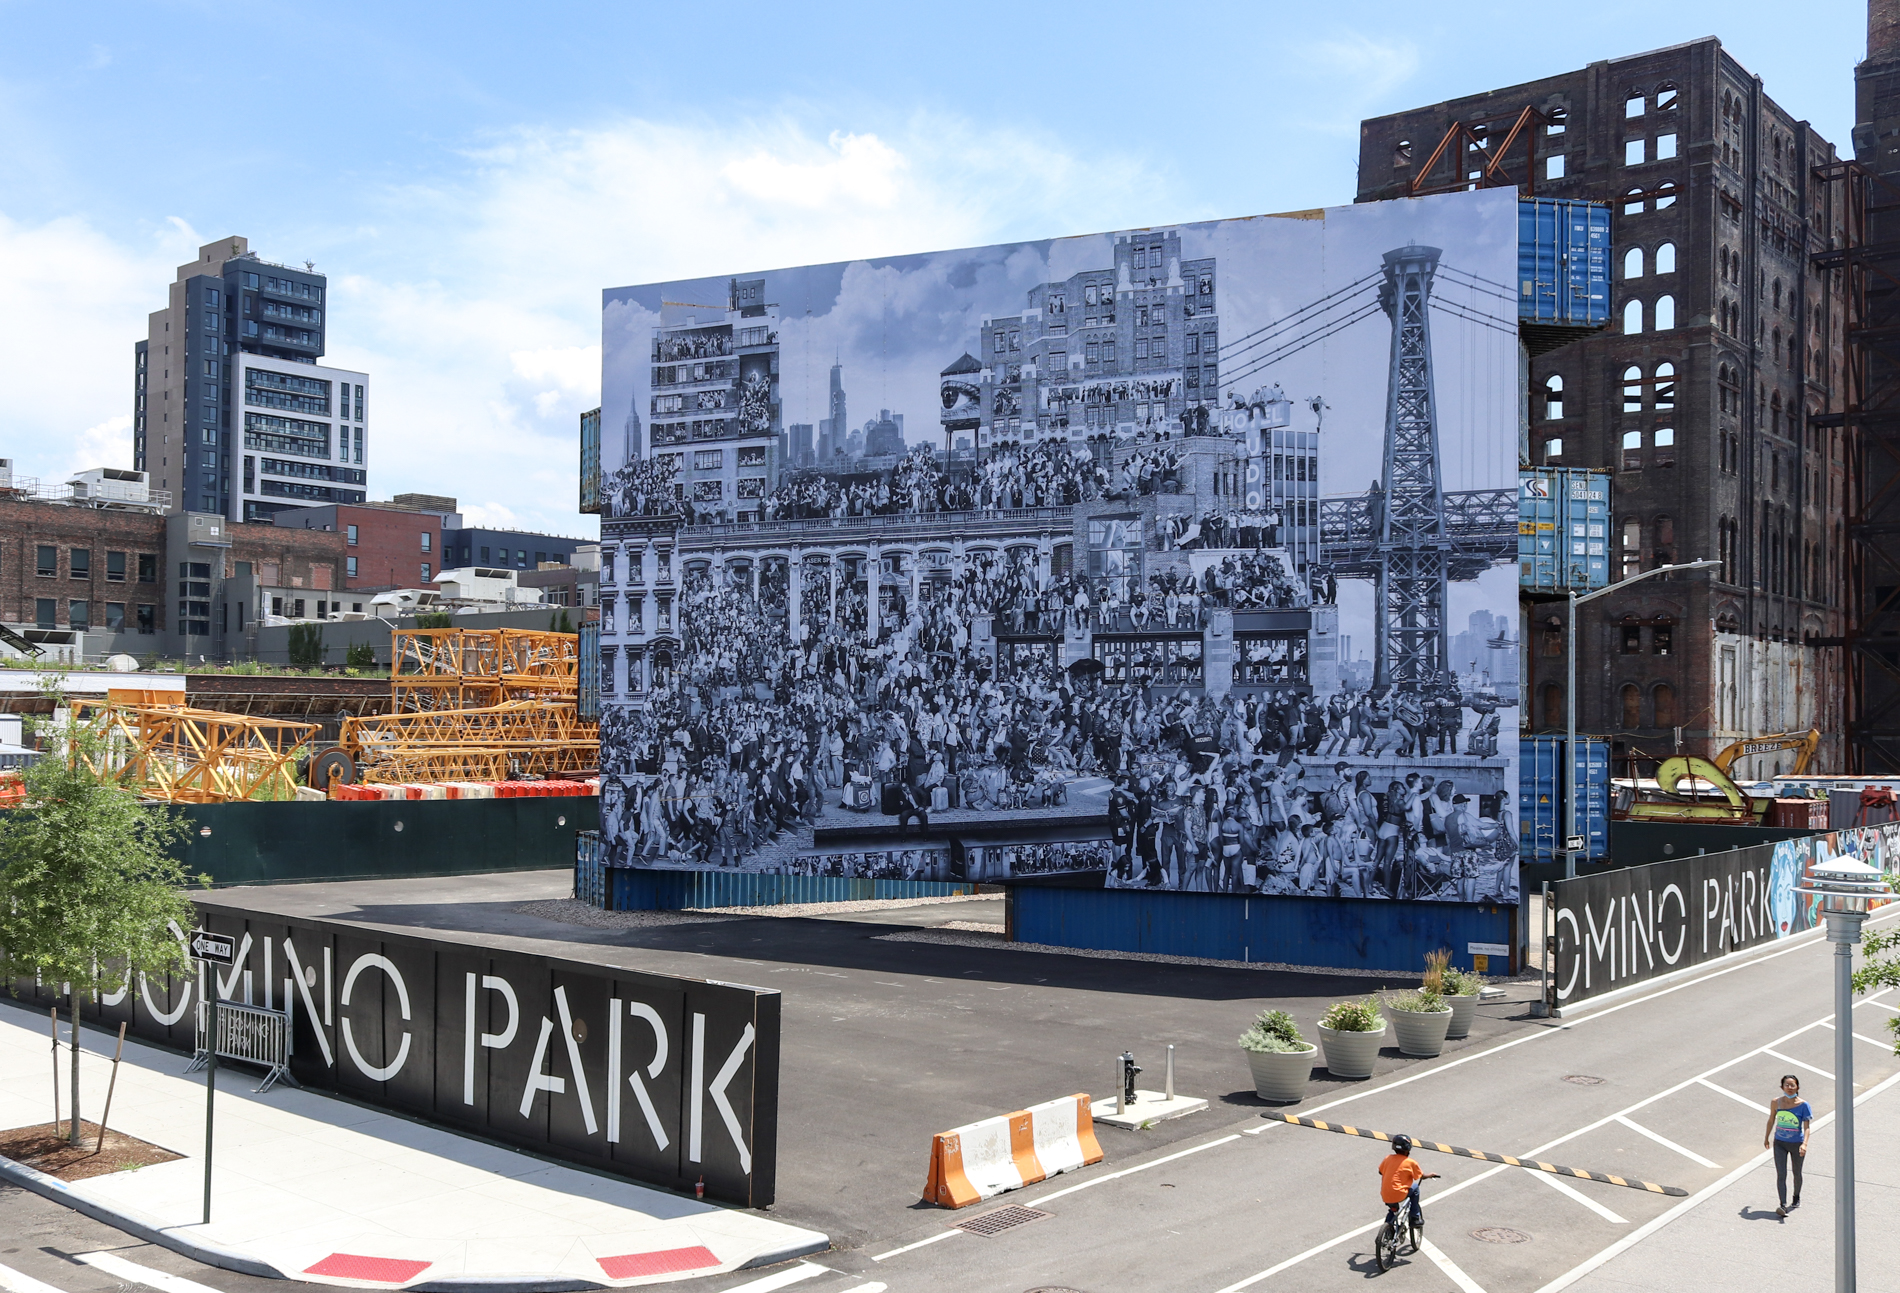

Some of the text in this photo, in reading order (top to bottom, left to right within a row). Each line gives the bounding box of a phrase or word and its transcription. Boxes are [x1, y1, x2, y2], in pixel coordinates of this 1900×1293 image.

[1744, 742, 1782, 754] BREEZE
[1703, 868, 1775, 954] PARK
[196, 940, 229, 955] ONE WAY
[229, 1016, 270, 1038] DOMINO
[463, 971, 755, 1176] PARK
